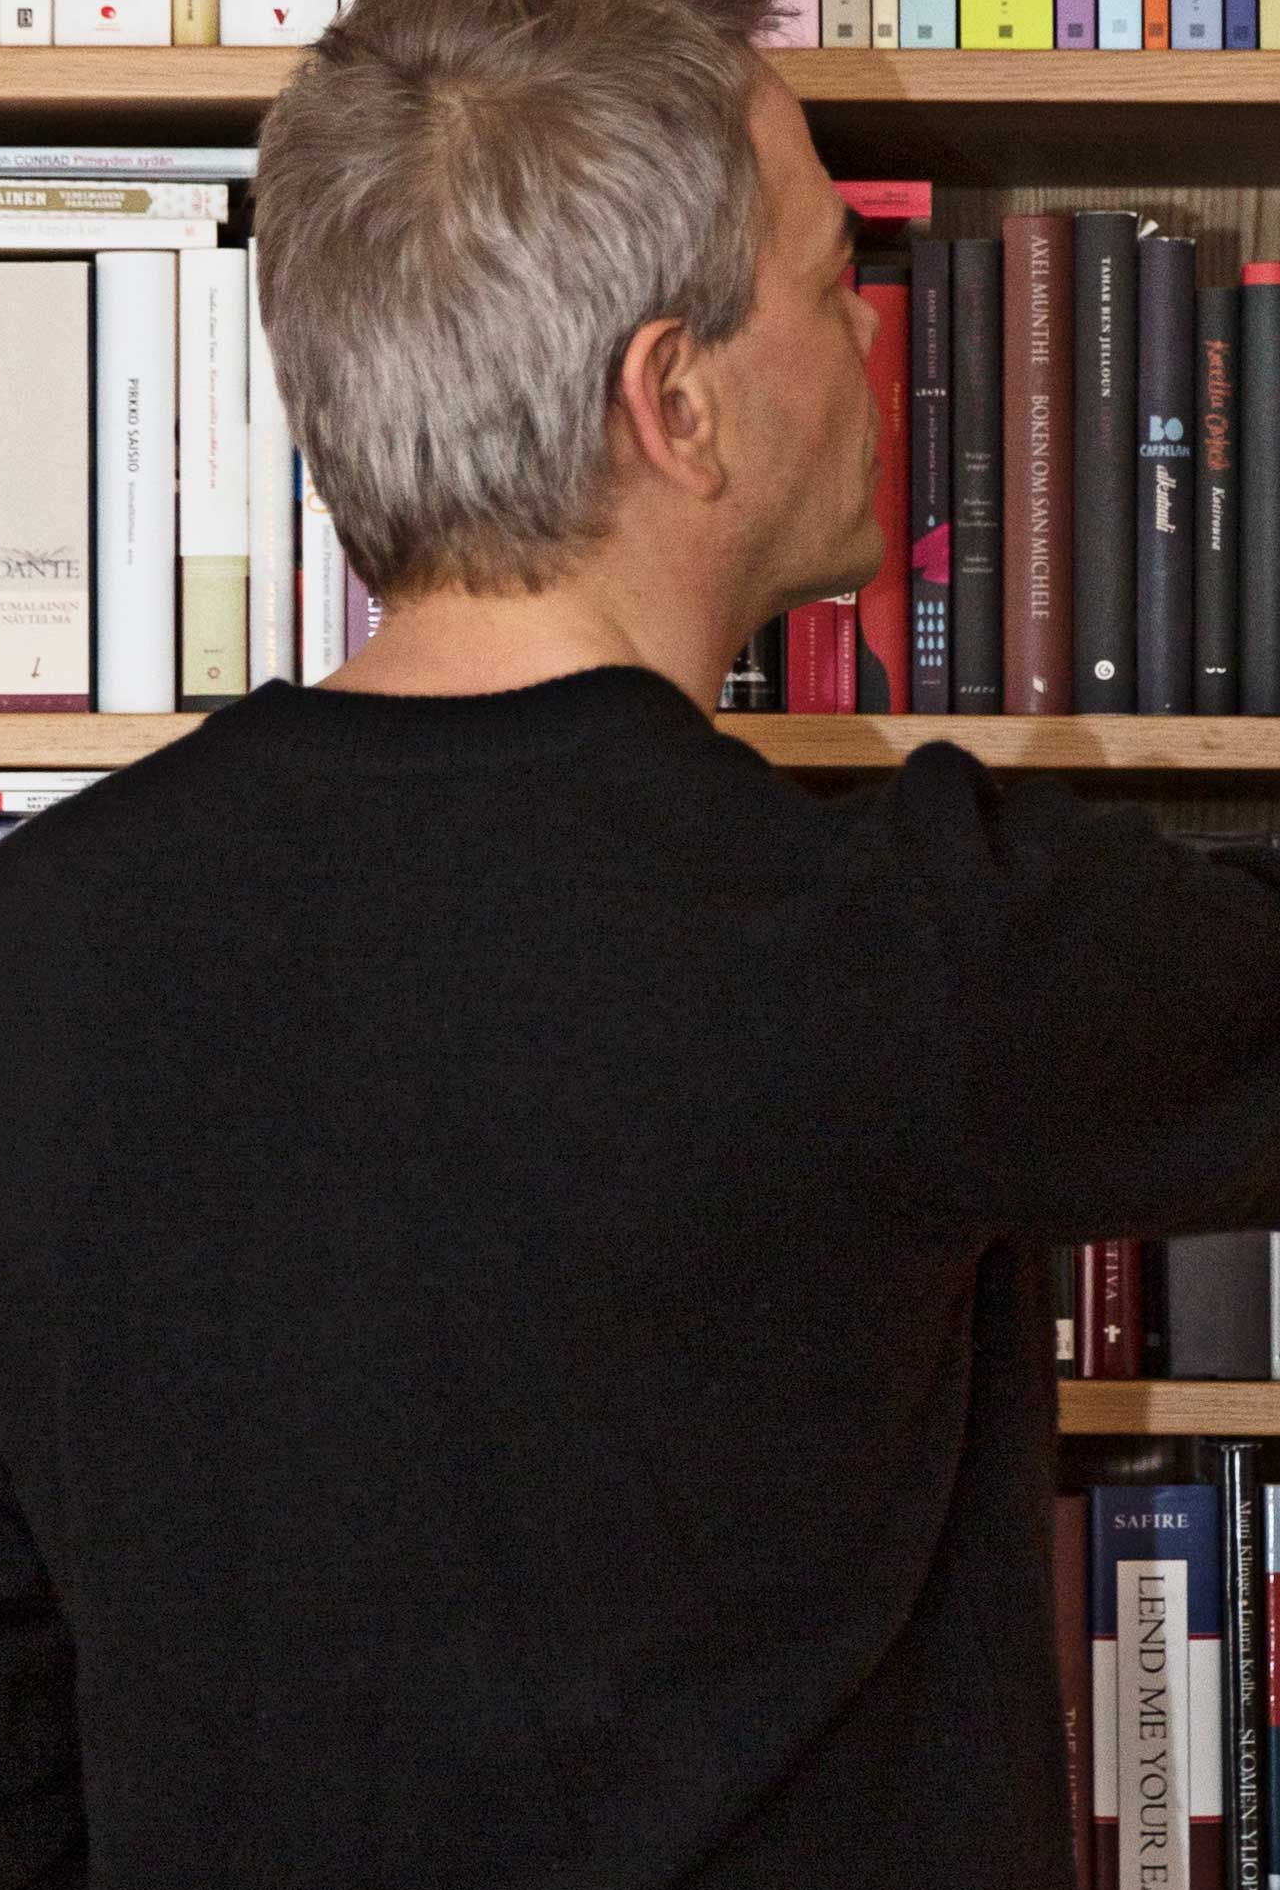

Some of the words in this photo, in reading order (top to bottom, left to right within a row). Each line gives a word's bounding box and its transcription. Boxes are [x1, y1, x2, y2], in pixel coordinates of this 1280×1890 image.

[1138, 1575, 1166, 1673] LEND
[1139, 1686, 1166, 1740] ME
[1139, 1747, 1166, 1855] YOUR
